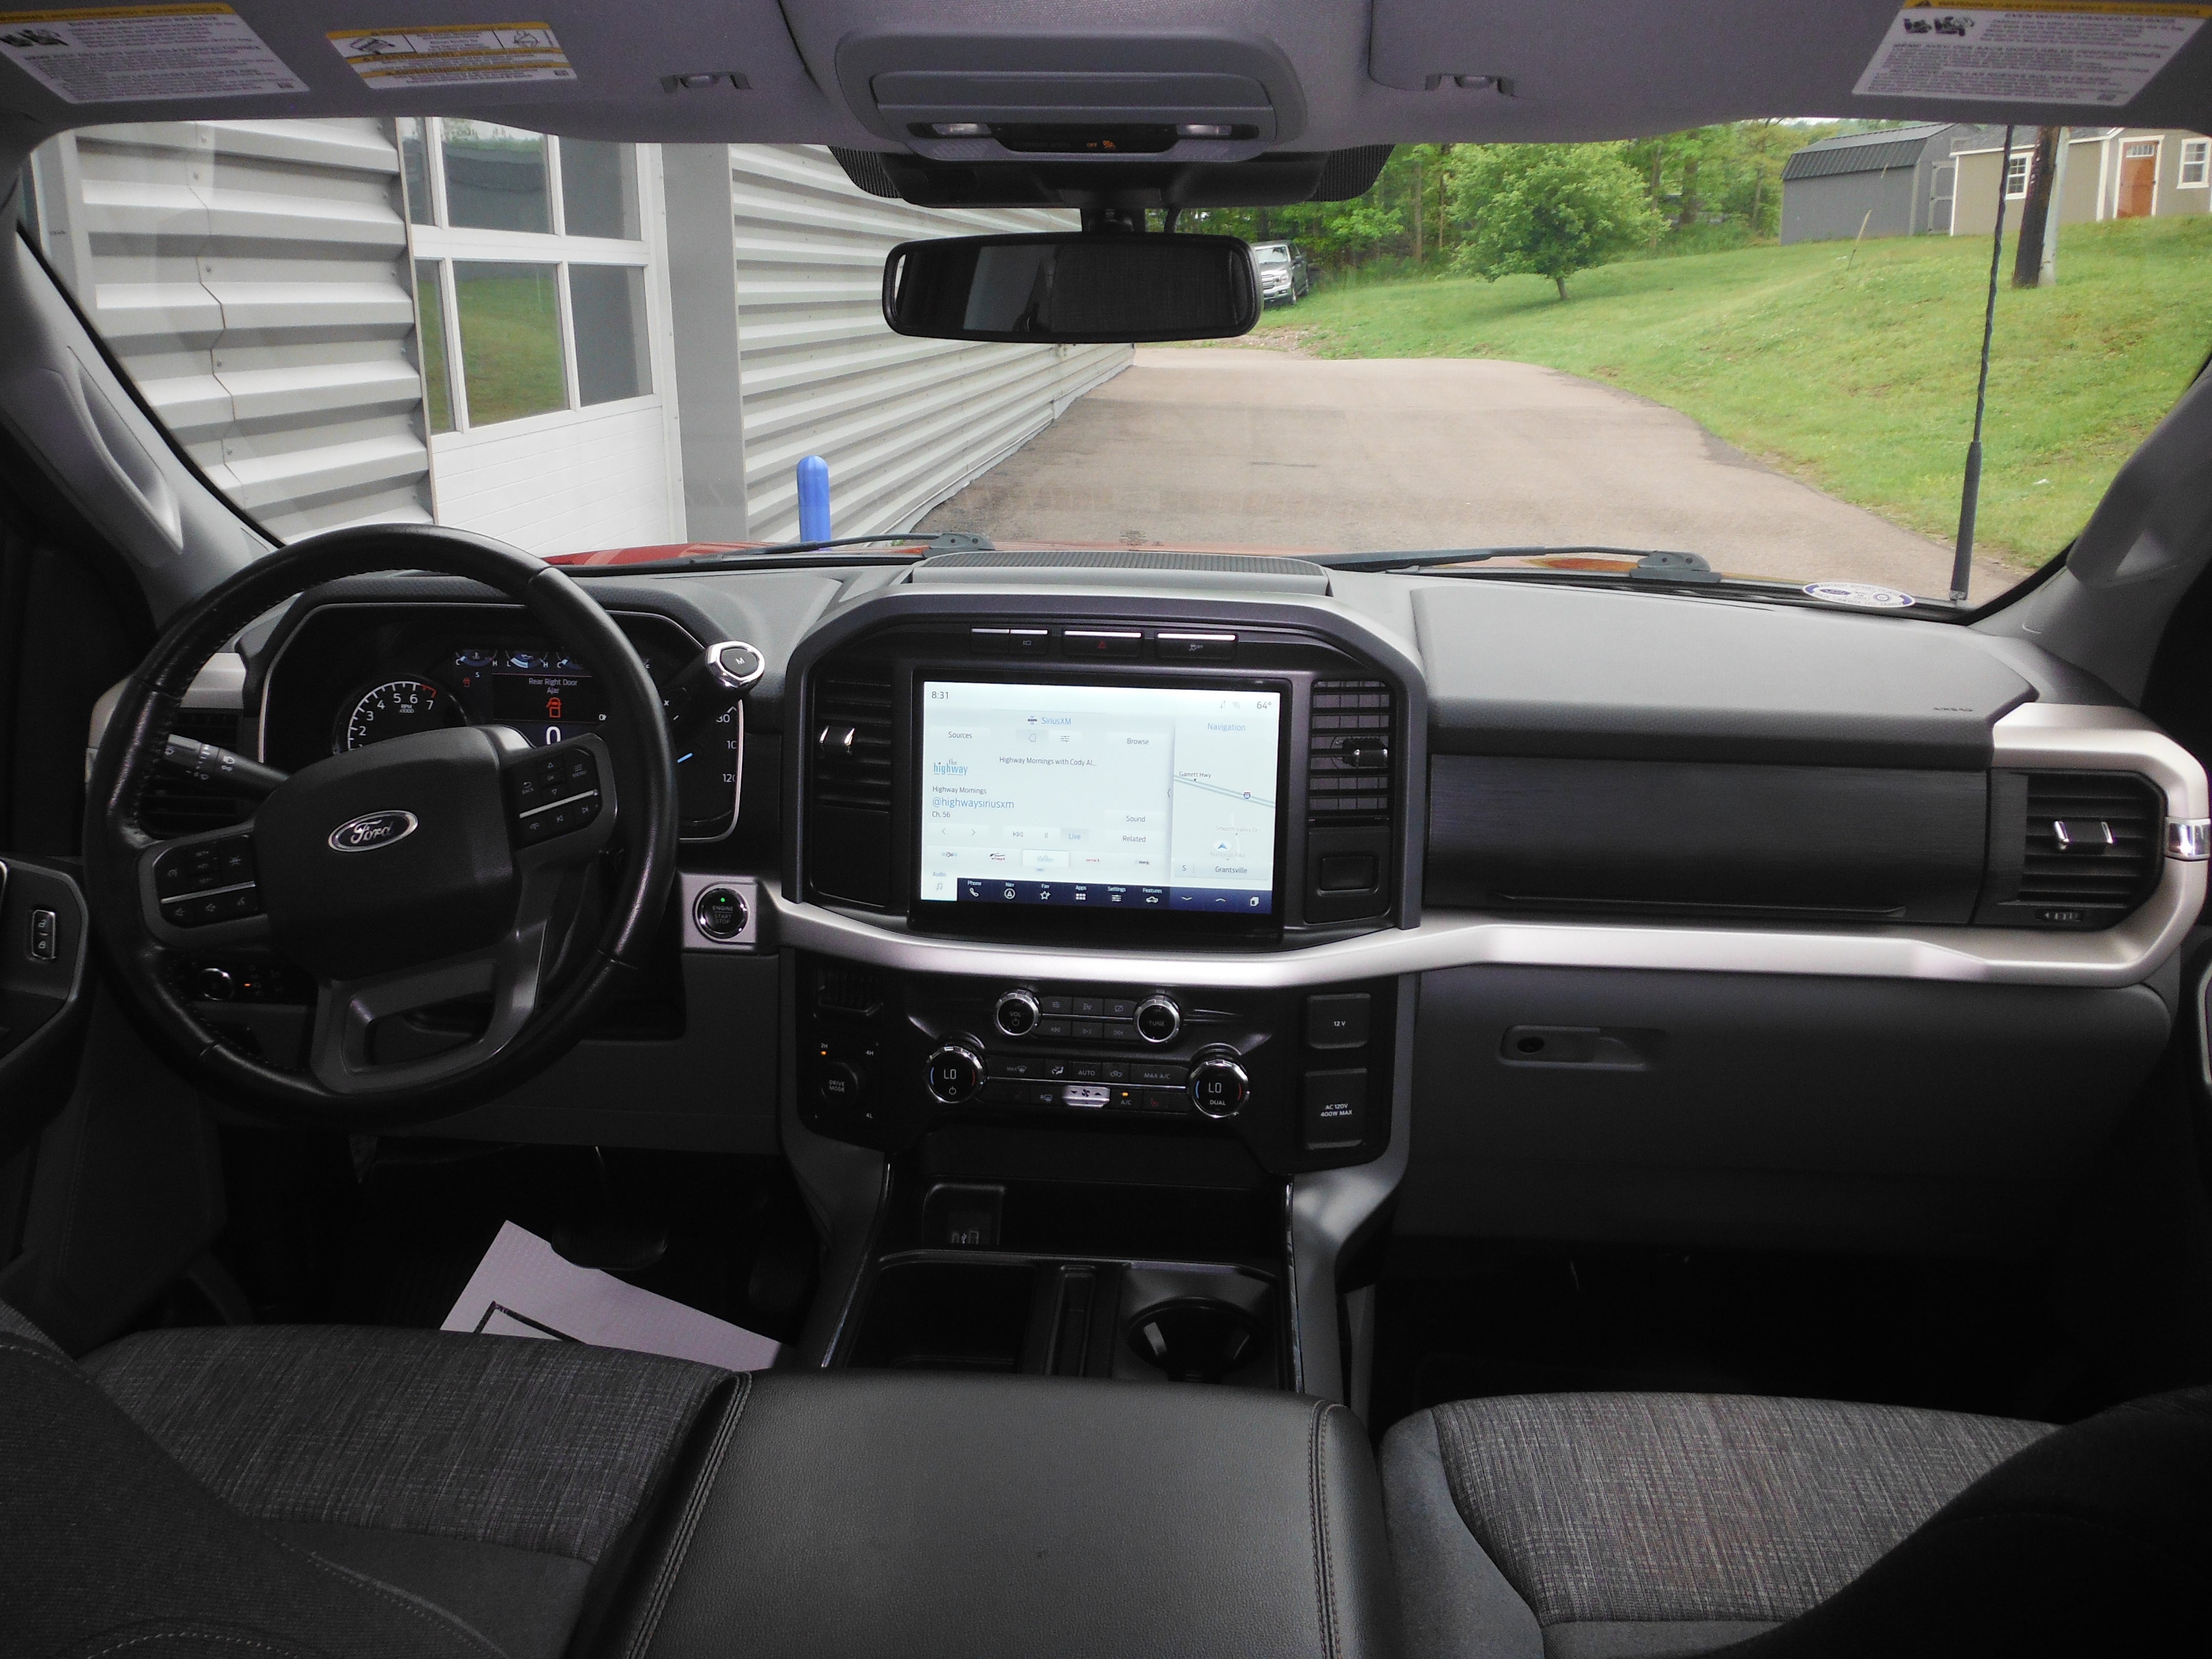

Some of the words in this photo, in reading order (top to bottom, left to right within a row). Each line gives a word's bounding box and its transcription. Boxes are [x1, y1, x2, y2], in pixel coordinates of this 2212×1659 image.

[735, 657, 745, 665] M
[545, 678, 561, 686] Right
[393, 693, 401, 704] 5
[410, 694, 418, 704] 6
[931, 691, 949, 699] 8:31
[377, 700, 385, 710] 4
[427, 700, 434, 710] 7
[367, 711, 374, 721] 3
[1041, 717, 1072, 725] SiriusXM
[359, 726, 366, 736] 2
[1207, 722, 1246, 732] Navigation
[933, 761, 968, 775] highway
[572, 770, 587, 778] MENU
[932, 797, 1014, 809] @highwaysiriusxm
[350, 819, 394, 844] Ford
